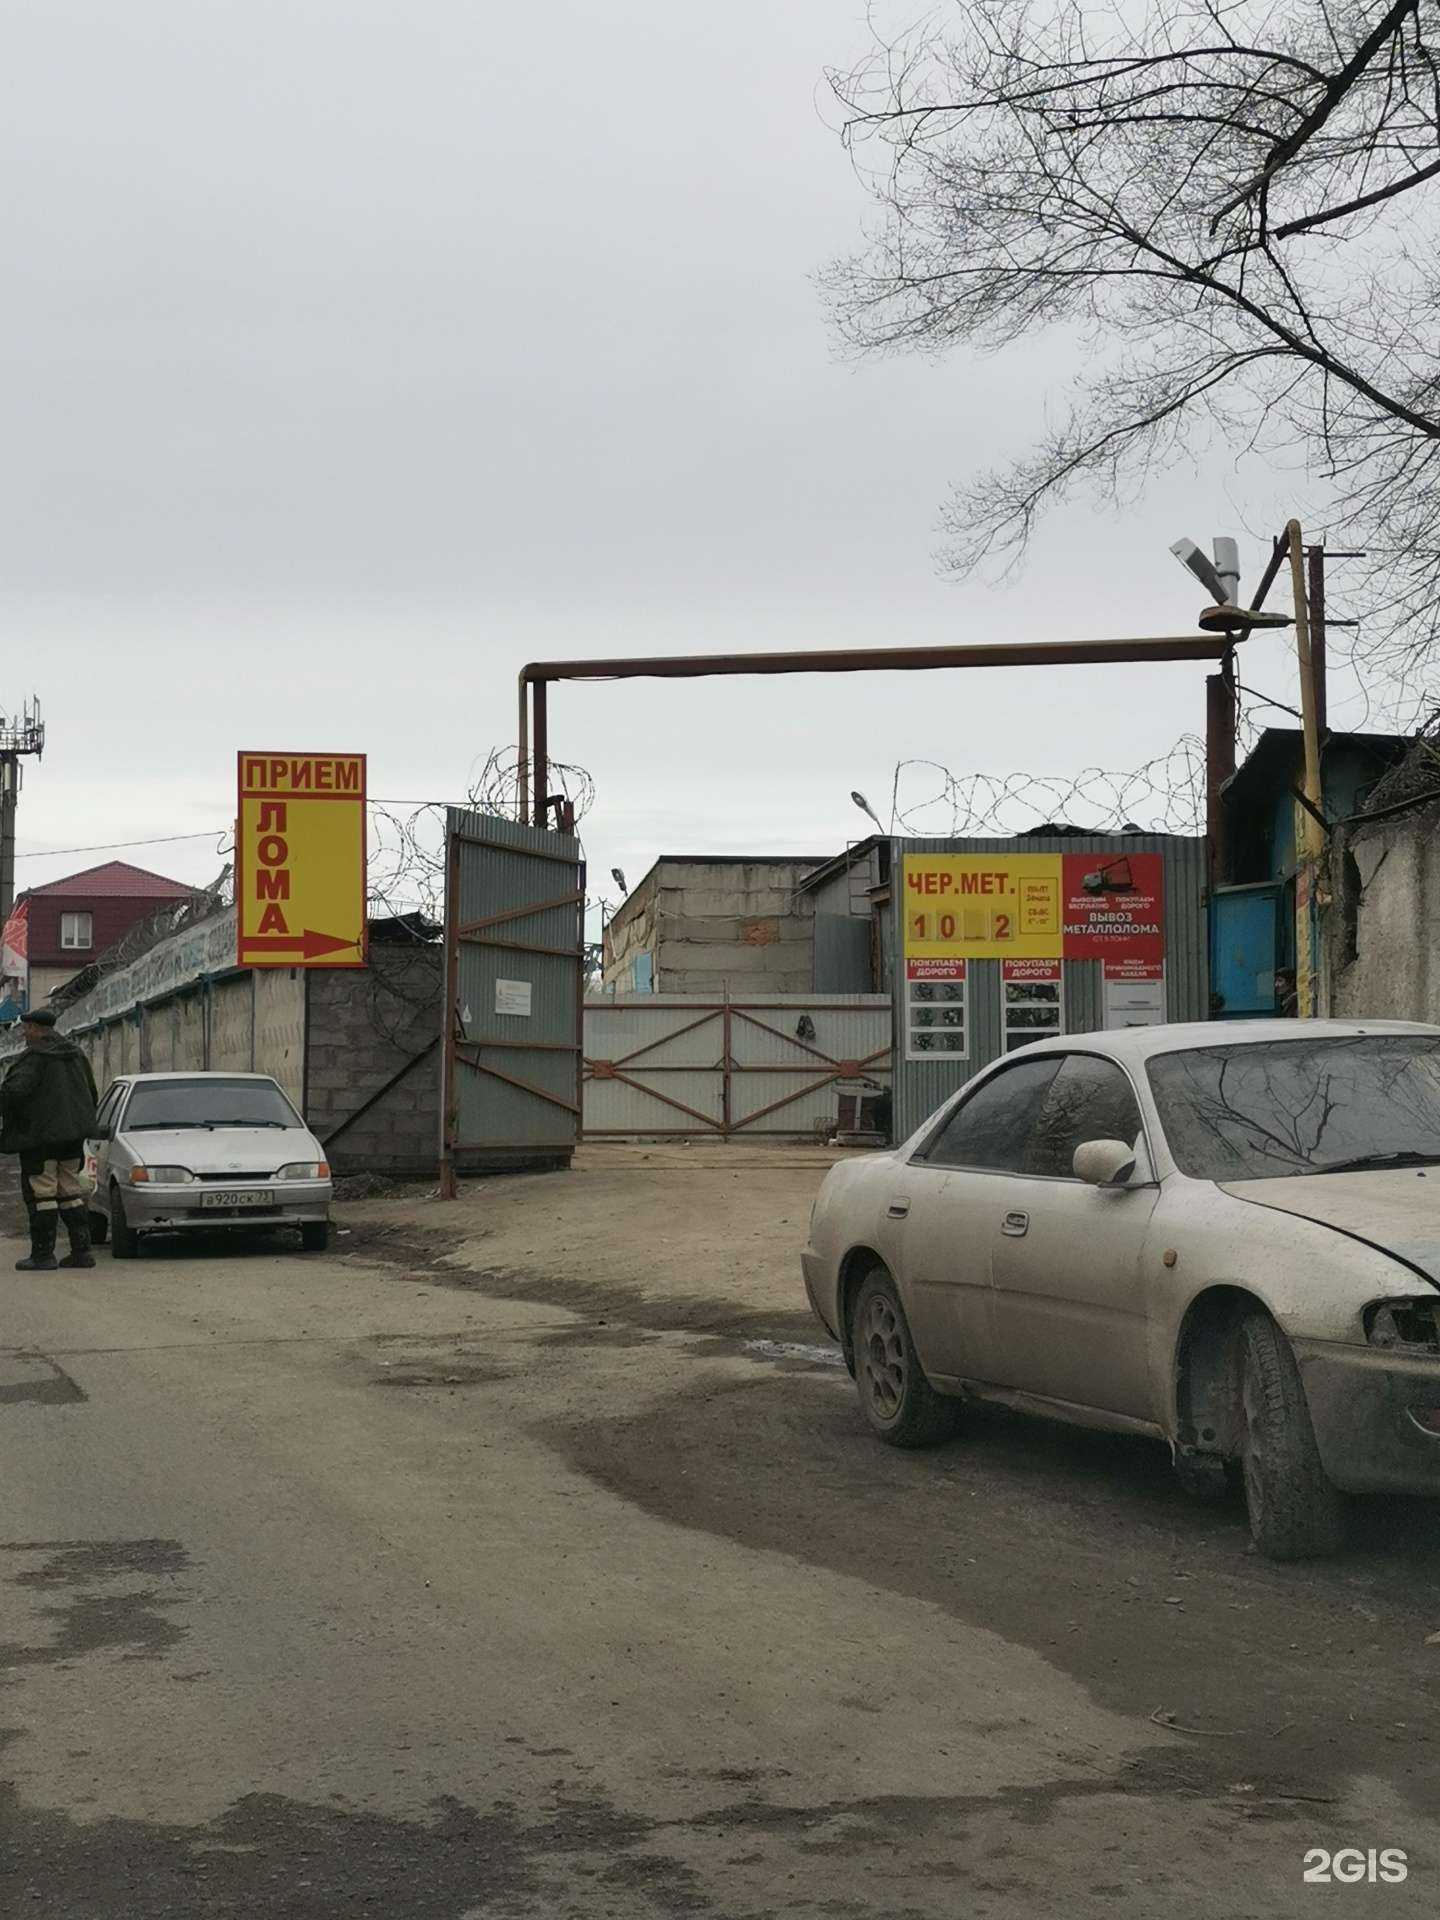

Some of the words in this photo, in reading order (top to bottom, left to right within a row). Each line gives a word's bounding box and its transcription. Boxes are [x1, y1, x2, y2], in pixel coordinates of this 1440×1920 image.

[246, 759, 359, 790] ПРИЕМ
[256, 801, 290, 934] ЛОМА
[1089, 912, 1133, 922] ВЫВОЗ
[1063, 924, 1160, 934] МЕТАЛЛОЛОМА
[910, 959, 964, 967] ПОКУПАЕМ
[1005, 959, 1059, 968] ПОКУПАЕМ
[916, 967, 957, 976] ДОРОГО
[1011, 968, 1052, 977] ДОРОГО
